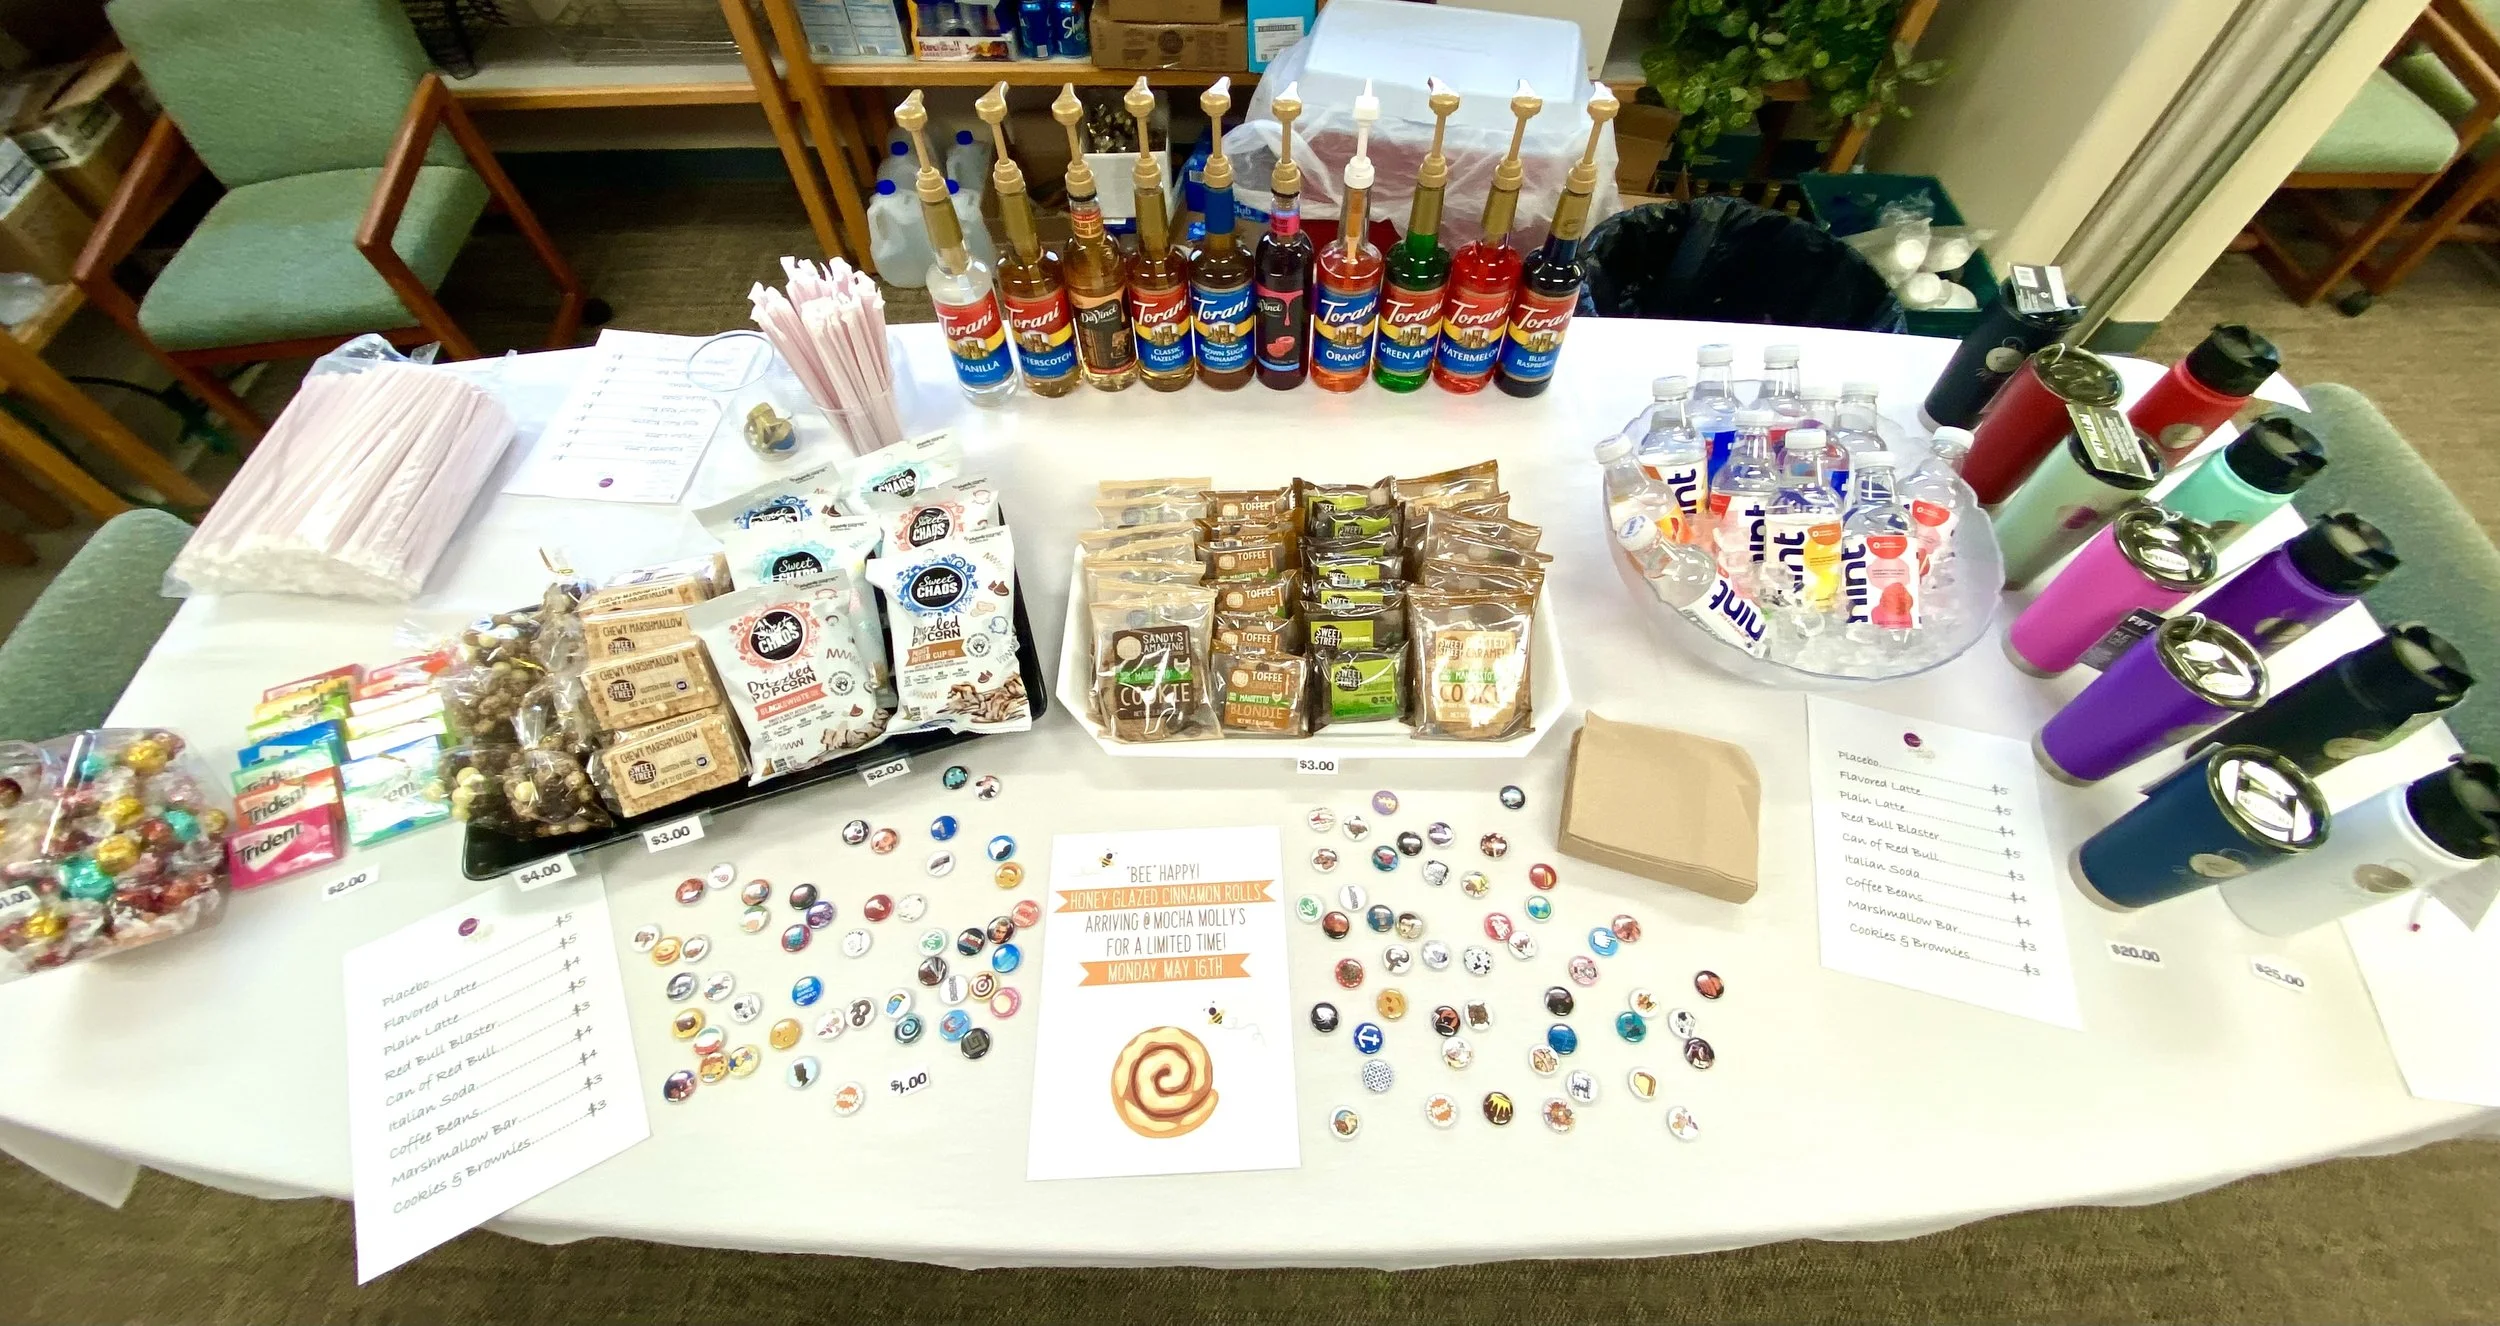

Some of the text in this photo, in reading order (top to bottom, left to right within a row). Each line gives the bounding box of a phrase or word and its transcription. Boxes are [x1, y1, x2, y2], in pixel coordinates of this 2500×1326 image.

[1004, 301, 1061, 329] Torani
[1081, 303, 1118, 324] DaVinci
[1133, 289, 1187, 326] Torani
[1193, 291, 1250, 322] Torani
[1321, 297, 1377, 325] Torani
[937, 304, 993, 336] Torani
[1150, 350, 1185, 363] HAZELNUT
[1153, 346, 1181, 357] CLASSIC
[1204, 353, 1243, 363] CINNAMON
[1226, 344, 1249, 356] SUGAR
[1325, 348, 1366, 362] ORANGE
[1380, 342, 1411, 360] GREEN
[957, 360, 1000, 373] VANILLA
[1667, 468, 1697, 515] int
[1240, 502, 1270, 511] TOFFEE
[912, 522, 946, 542] CHAOS
[779, 556, 814, 573] Sweet
[1237, 550, 1267, 561] TOFFEE
[916, 583, 958, 599] CHAOS
[919, 573, 955, 588] Sweet
[1245, 588, 1276, 598] TOFFEE
[602, 617, 683, 638] CHEWY MARSHMALLOW
[1142, 632, 1184, 645] SANDY'S
[1240, 632, 1272, 644] TOFFEE
[1315, 627, 1342, 638] SWEET
[1143, 642, 1184, 652] AMAZING
[1315, 636, 1342, 647] STREET
[1438, 641, 1464, 650] SWEET
[932, 650, 947, 659] CUP
[600, 653, 680, 682] CHEWY MARSHMALLOW
[1251, 670, 1284, 683] TOFFEE
[1336, 669, 1362, 680] SWEET
[608, 682, 636, 692] SWEET
[746, 664, 814, 694] Drizzled
[752, 672, 817, 704] POPCORN
[608, 690, 636, 700] STREET
[1230, 704, 1284, 720] BLONDIE
[620, 728, 698, 764] CHEWY MARSHMALLOW
[628, 762, 656, 774] SWEET
[628, 770, 656, 782] STREET
[866, 762, 904, 781] $2.00
[1299, 760, 1335, 772] $3.00
[1838, 750, 2009, 796] Placebo $5
[1840, 770, 2012, 816] Flavored Latte $5
[242, 784, 308, 825] Trident
[1840, 790, 2016, 838] Plain Latte $4
[234, 821, 303, 865] Trident
[651, 826, 691, 846] $3.00
[1841, 812, 2022, 860] Red Bull Blaster $5
[1842, 832, 2025, 882] Can of Red Bull $3
[520, 863, 562, 885] $4.00
[1126, 863, 1200, 883] "BEE" HAPPY!
[1845, 854, 2027, 904] Italian Soda $4
[328, 873, 367, 896] $2.00
[1070, 883, 1262, 910] HONEY GLAZED CINNAMON ROLLS
[1846, 876, 2032, 928] Coffee Beans $4
[1085, 908, 1246, 934] ARRIVING @ MOCHA MOLLY'S
[1848, 900, 2037, 952] Marshmallow Bar $3
[1106, 932, 1226, 958] FOR A LIMITED TIME!
[1850, 922, 2041, 976] Cookies & Brownies $3
[2111, 944, 2161, 963] $20.00
[382, 912, 574, 1007] Placebo $5
[1108, 958, 1224, 983] MONDAY MAY 16TH
[384, 933, 578, 1032] Flavored Latte $5
[2254, 962, 2305, 988] $25.00
[384, 956, 581, 1056] Plain Latte $4
[384, 976, 588, 1080] Red Bull Blaster $5
[386, 1001, 591, 1106] Can of Red Bull $3
[388, 1025, 594, 1132] Italian Soda $4
[890, 1072, 927, 1094] $1.00
[390, 1048, 598, 1160] Coffee Beans $4
[391, 1074, 603, 1187] Marshmallow Bar $3
[393, 1100, 608, 1214] Cookies & Brownies $3
